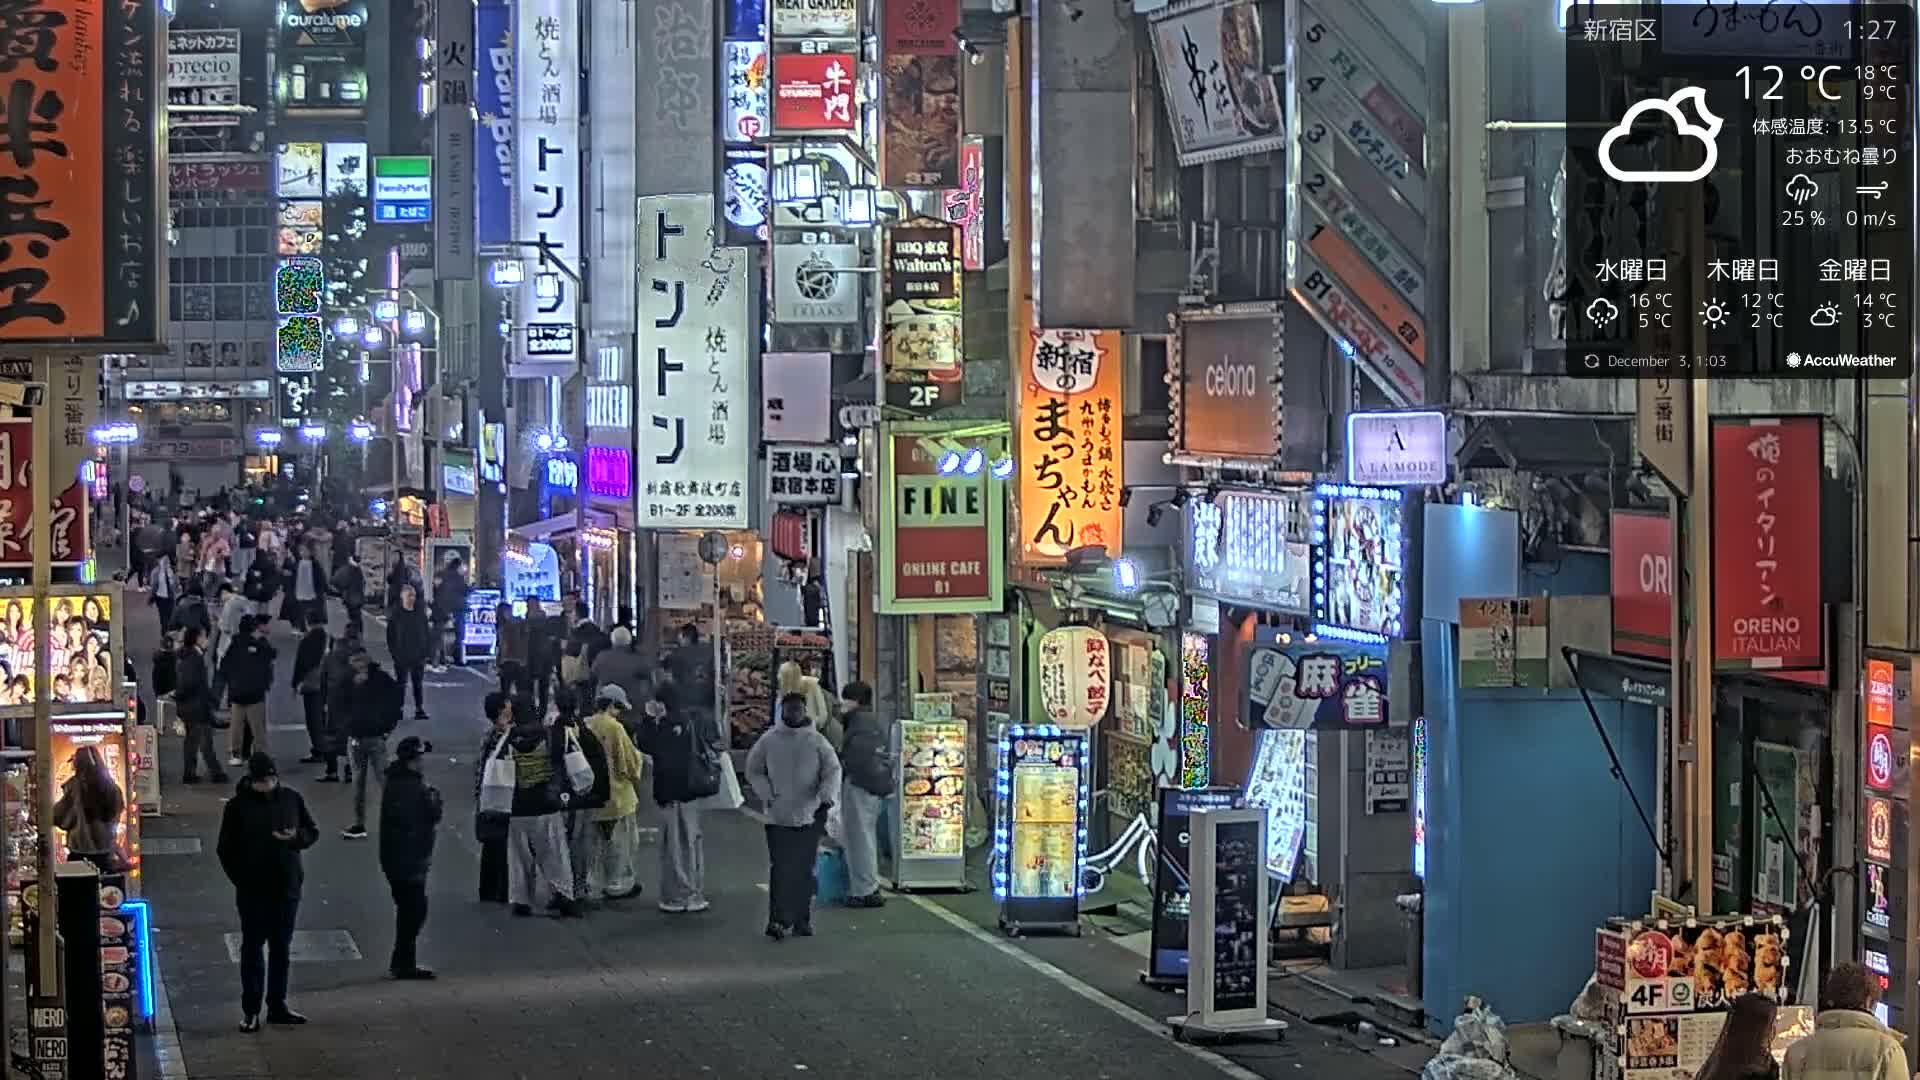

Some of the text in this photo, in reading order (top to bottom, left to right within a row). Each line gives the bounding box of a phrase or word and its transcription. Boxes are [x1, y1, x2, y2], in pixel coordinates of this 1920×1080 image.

[287, 12, 361, 27] auralume
[1306, 24, 1326, 43] 5
[443, 40, 467, 105] 火鍋
[535, 16, 562, 127] 焼とん酒場
[821, 60, 852, 122] 牛門
[1307, 76, 1326, 92] 4
[1307, 124, 1326, 143] 3
[379, 183, 428, 194] FamilyMart
[1306, 174, 1326, 194] 2
[895, 241, 923, 256] BBQ
[893, 258, 953, 274] Walton's
[1304, 270, 1332, 299] B1
[650, 208, 686, 464] トントン
[1035, 341, 1096, 376] 新宿
[704, 326, 730, 446] 焼とん酒場
[1057, 374, 1077, 390] の
[909, 386, 940, 407] 2F
[1033, 397, 1078, 547] まっちゃん
[1393, 462, 1437, 473] MODE
[646, 480, 741, 497] 新宿歌舞伎町店
[771, 477, 836, 495] 新宿本店
[903, 485, 980, 515] FINE
[1746, 432, 1783, 606] 俺のイタリアン
[903, 561, 981, 577] ONLINE CAFE
[1733, 616, 1801, 635] ORENO
[1732, 634, 1802, 654] ITALIAN
[1631, 983, 1664, 1008] 4F
[33, 1007, 65, 1029] NERO
[36, 1039, 67, 1059] NERO
